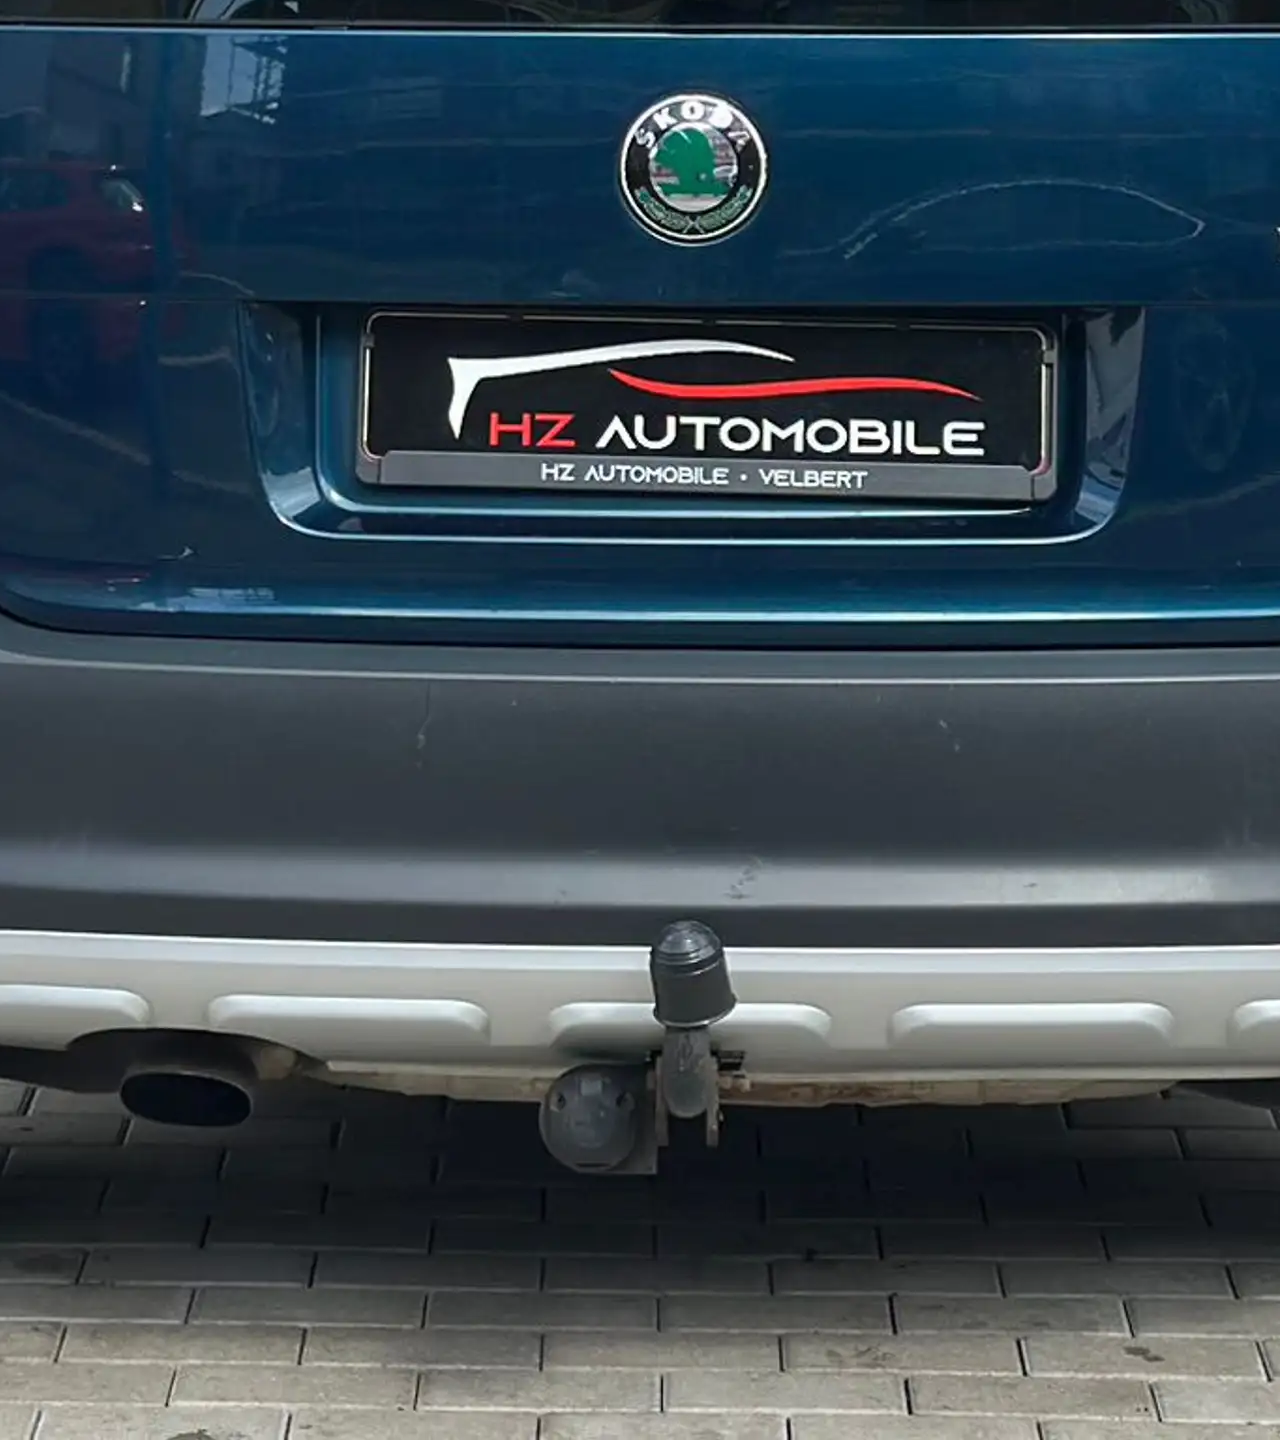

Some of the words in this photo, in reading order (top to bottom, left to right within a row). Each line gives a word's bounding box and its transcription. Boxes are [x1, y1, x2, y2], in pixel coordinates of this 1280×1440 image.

[489, 412, 576, 448] HZ
[595, 413, 985, 457] AUTOMOBILE
[540, 461, 576, 482] HZ
[583, 463, 730, 486] AUTOMOBILE
[757, 468, 869, 490] VELBERT
